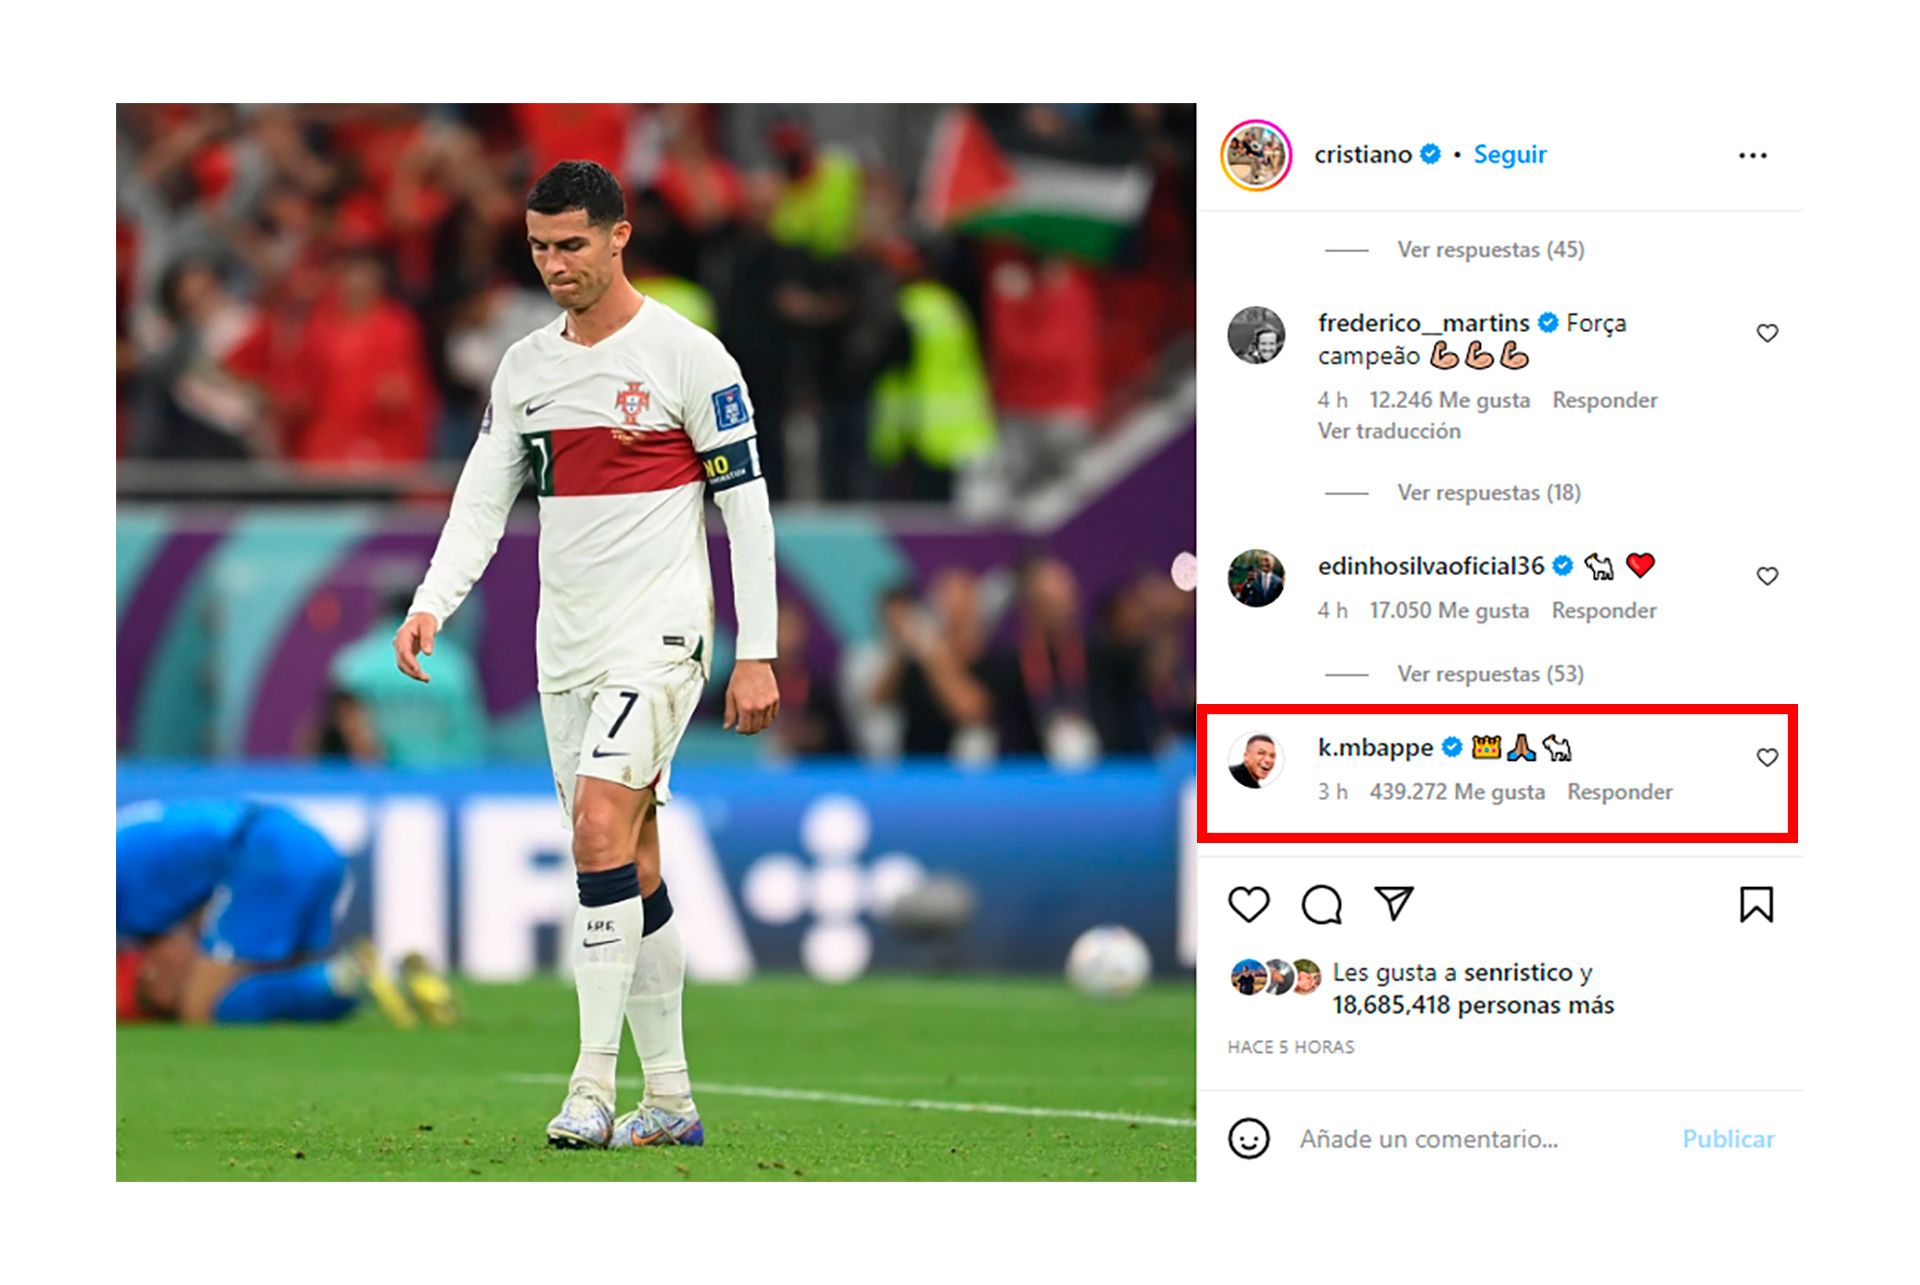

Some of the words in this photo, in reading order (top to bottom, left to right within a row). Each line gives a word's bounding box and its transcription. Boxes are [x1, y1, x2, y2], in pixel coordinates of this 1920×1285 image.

[1313, 143, 1414, 165] cristiano
[1474, 143, 1549, 170] Seguir
[1397, 241, 1431, 258] Ver
[1436, 242, 1541, 264] respuestas
[1546, 240, 1585, 262] (45)
[1317, 312, 1531, 337] frederico__martins
[1566, 312, 1628, 339] Força
[1316, 344, 1421, 371] campeão
[1317, 391, 1331, 408] 4
[1336, 391, 1348, 409] h
[1370, 390, 1433, 409] 12.246
[1439, 390, 1471, 409] Me
[1476, 392, 1531, 414] gusta
[1553, 390, 1659, 414] Responder
[1317, 422, 1351, 440] Ver
[1355, 421, 1462, 440] traducción
[703, 454, 730, 478] NO
[1397, 484, 1431, 501] Ver
[1436, 485, 1541, 507] respuestas
[1546, 483, 1582, 505] (18)
[1317, 553, 1546, 577] edinhosilvaoficial36
[1317, 601, 1331, 619] 4
[1336, 601, 1348, 619] h
[1370, 600, 1433, 619] 17.050
[1438, 601, 1470, 619] Me
[1475, 603, 1530, 625] gusta
[1551, 600, 1658, 624] Responder
[1397, 665, 1431, 682] Ver
[1436, 666, 1541, 688] respuestas
[1546, 664, 1585, 686] (53)
[607, 691, 640, 740] 7
[1318, 736, 1435, 763] k.mbappe
[1318, 782, 1330, 801] 3
[1336, 782, 1348, 800] h
[1369, 782, 1448, 801] 439.272
[1454, 782, 1488, 801] Me
[1491, 784, 1547, 806] gusta
[1567, 782, 1674, 806] Responder
[1333, 961, 1370, 983] Les
[1375, 963, 1438, 988] gusta
[1443, 966, 1457, 982] a
[1463, 961, 1573, 983] senristico
[1580, 966, 1594, 988] y
[1332, 993, 1452, 1016] 18,685,418
[1457, 999, 1562, 1020] personas
[1568, 993, 1616, 1015] más
[1228, 1039, 1274, 1055] HACE
[1279, 1039, 1289, 1055] 5
[1295, 1039, 1356, 1055] HORAS
[1299, 1128, 1373, 1149] Añade
[1379, 1134, 1408, 1149] un
[1415, 1129, 1558, 1149] comentario...
[1683, 1128, 1776, 1149] Publicar
